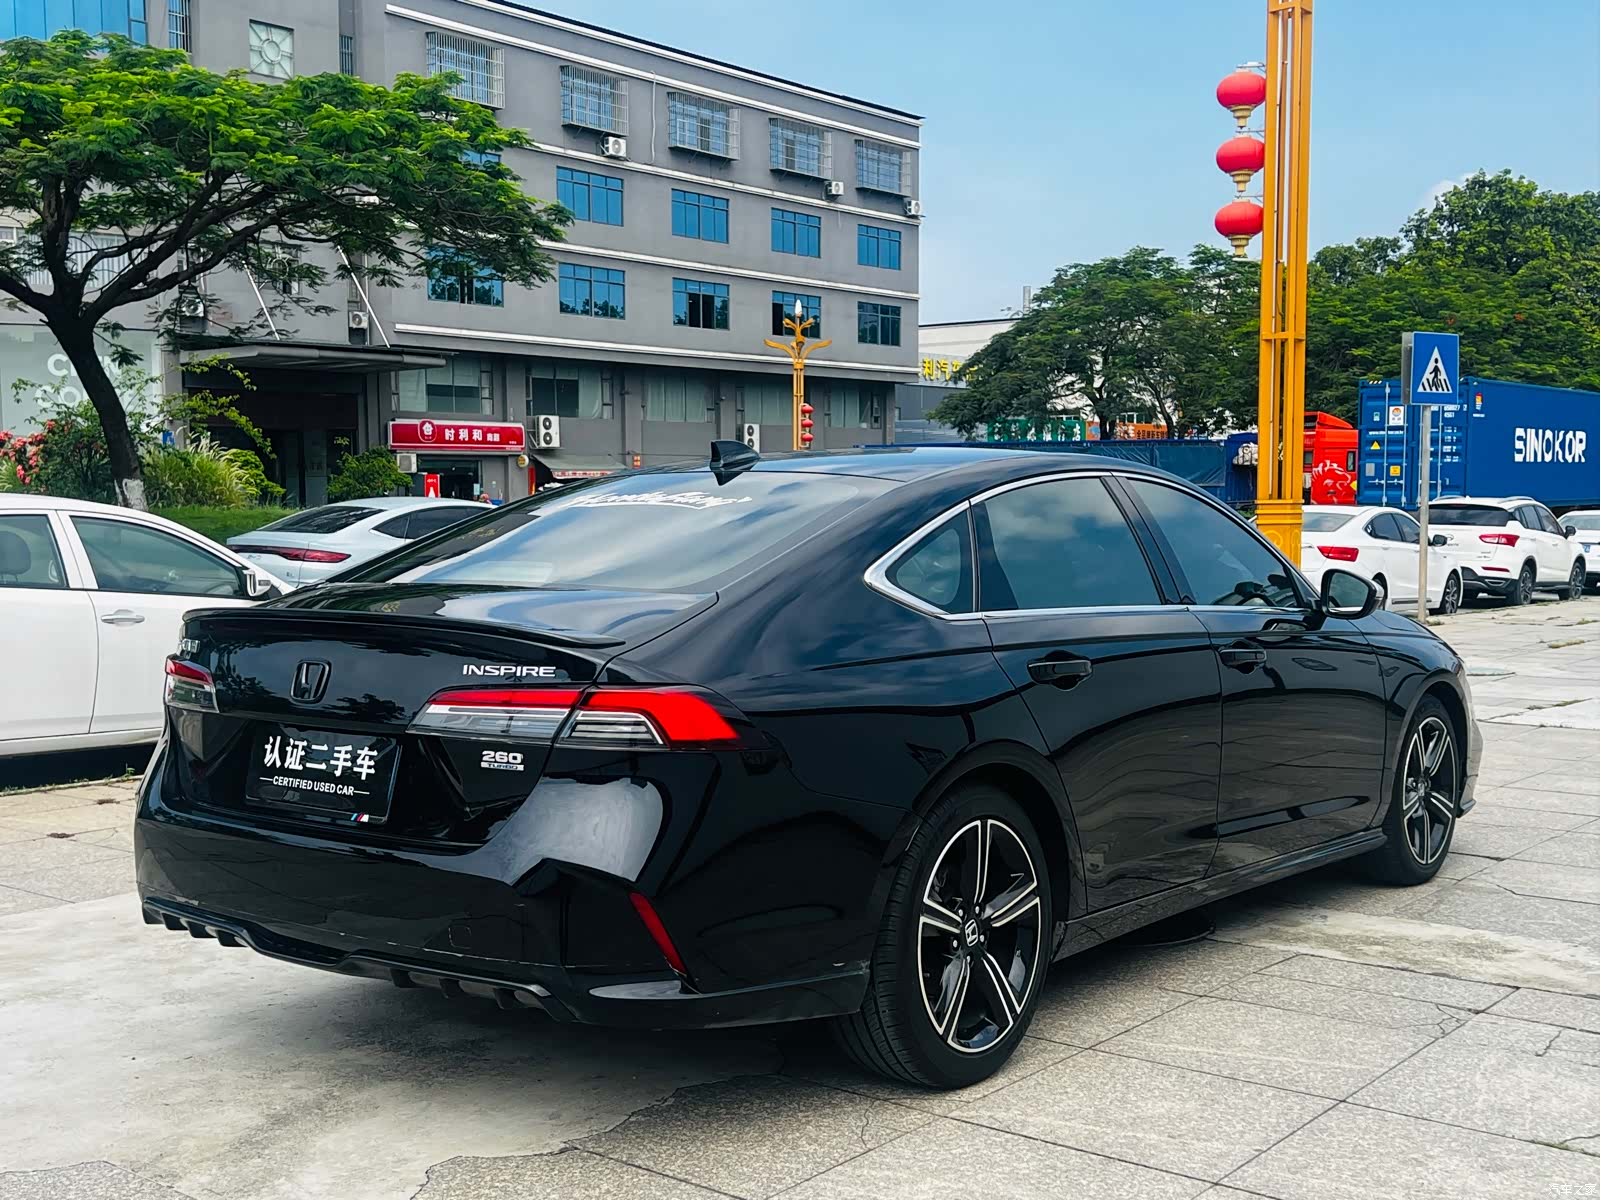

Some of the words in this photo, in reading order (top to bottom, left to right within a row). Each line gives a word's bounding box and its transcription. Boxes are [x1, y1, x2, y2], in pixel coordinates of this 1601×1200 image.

[1514, 427, 1587, 463] SINOKOR
[463, 664, 556, 677] INSPIRE
[263, 736, 378, 781] 认证二手车
[482, 750, 523, 764] 260
[272, 775, 313, 790] CERTIFIED
[313, 782, 336, 794] USED
[336, 785, 355, 796] CAR
